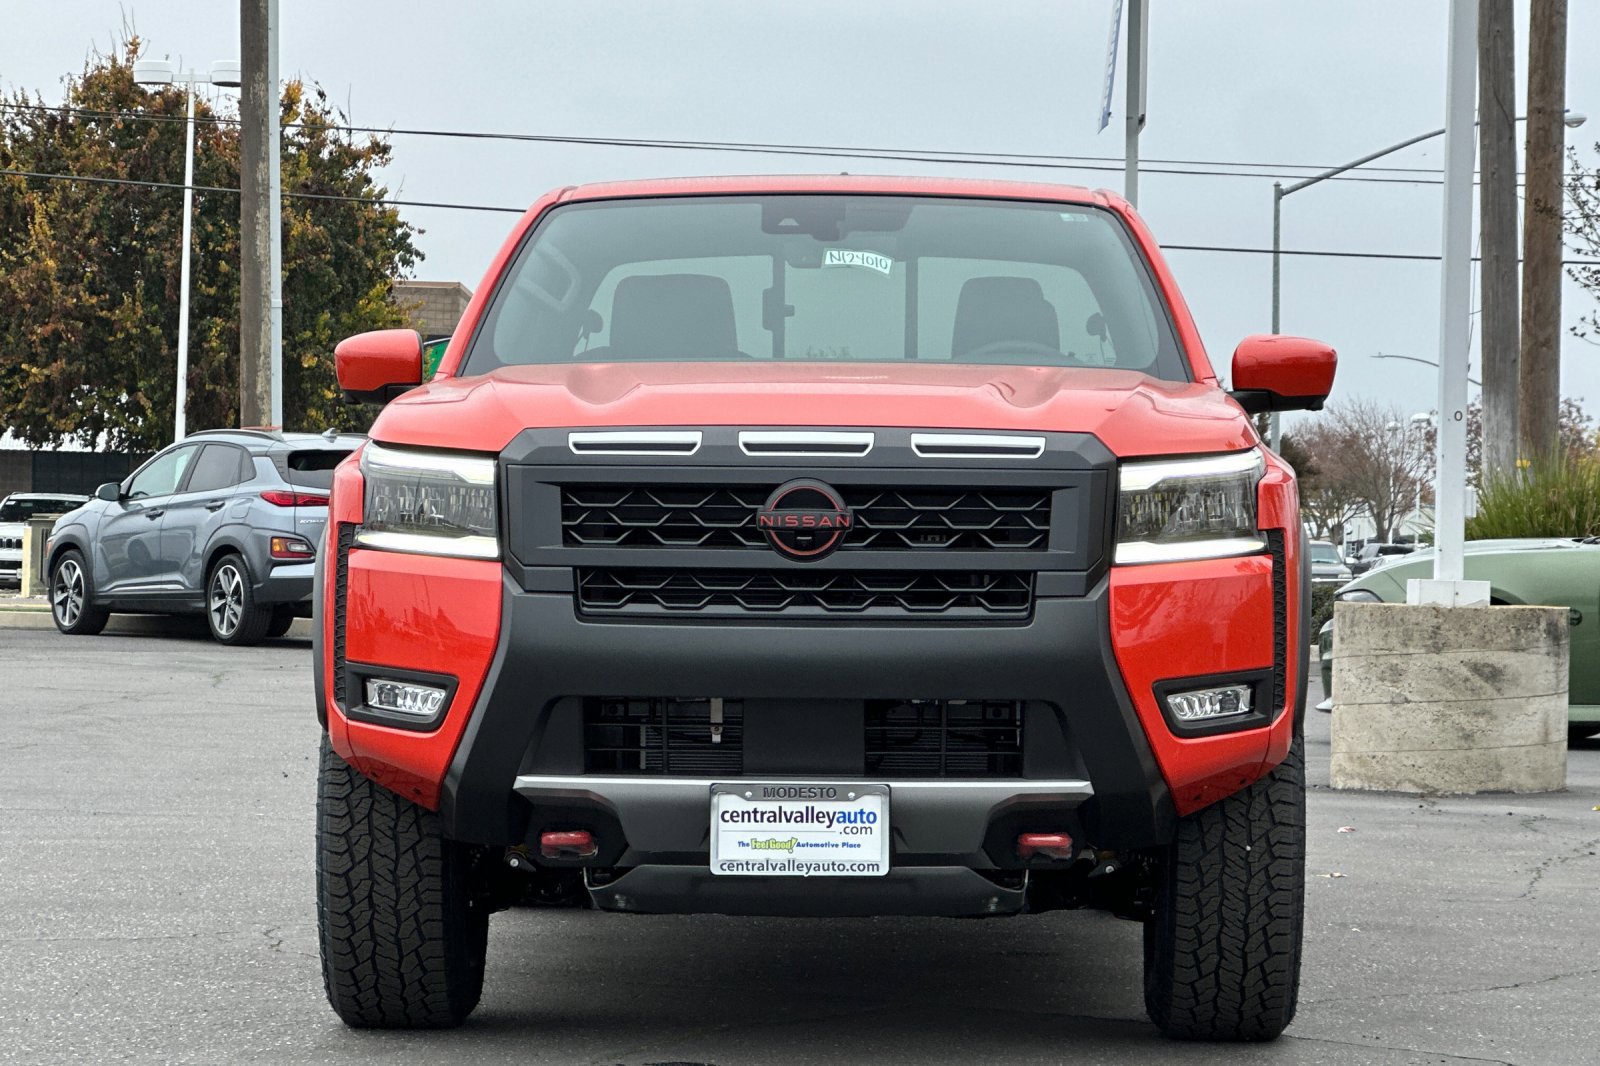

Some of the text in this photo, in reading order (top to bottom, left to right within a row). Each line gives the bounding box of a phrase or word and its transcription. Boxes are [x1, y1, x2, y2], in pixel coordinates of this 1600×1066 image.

[760, 515, 850, 528] NISSAN
[763, 787, 837, 799] MODESTO
[839, 826, 873, 835] .com
[841, 841, 861, 849] Place
[720, 859, 880, 876] centralvalleyauto.com
